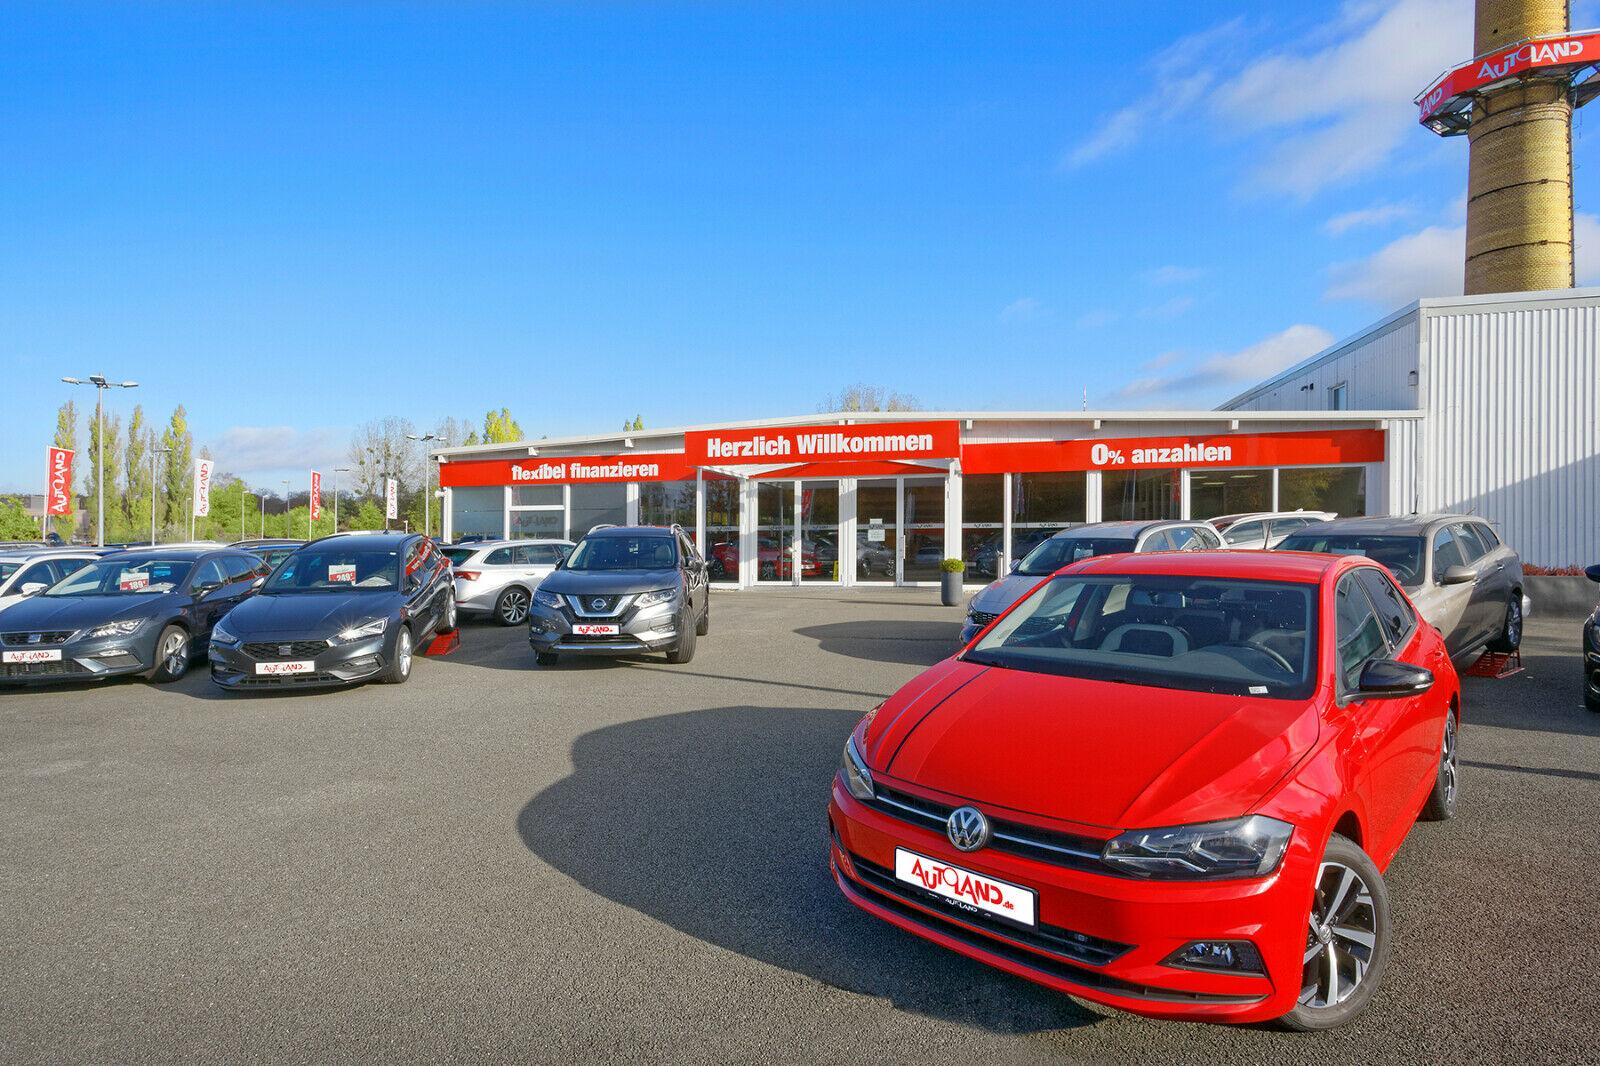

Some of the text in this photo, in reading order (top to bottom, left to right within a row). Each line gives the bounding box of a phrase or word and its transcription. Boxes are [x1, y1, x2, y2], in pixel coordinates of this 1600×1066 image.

[1477, 41, 1584, 80] AUTOLAND
[707, 432, 933, 458] Herzlich Willkommen
[1091, 443, 1232, 465] 0% anzahlen
[51, 451, 68, 512] AUTOLAND
[511, 461, 659, 480] flexibel finanzieren
